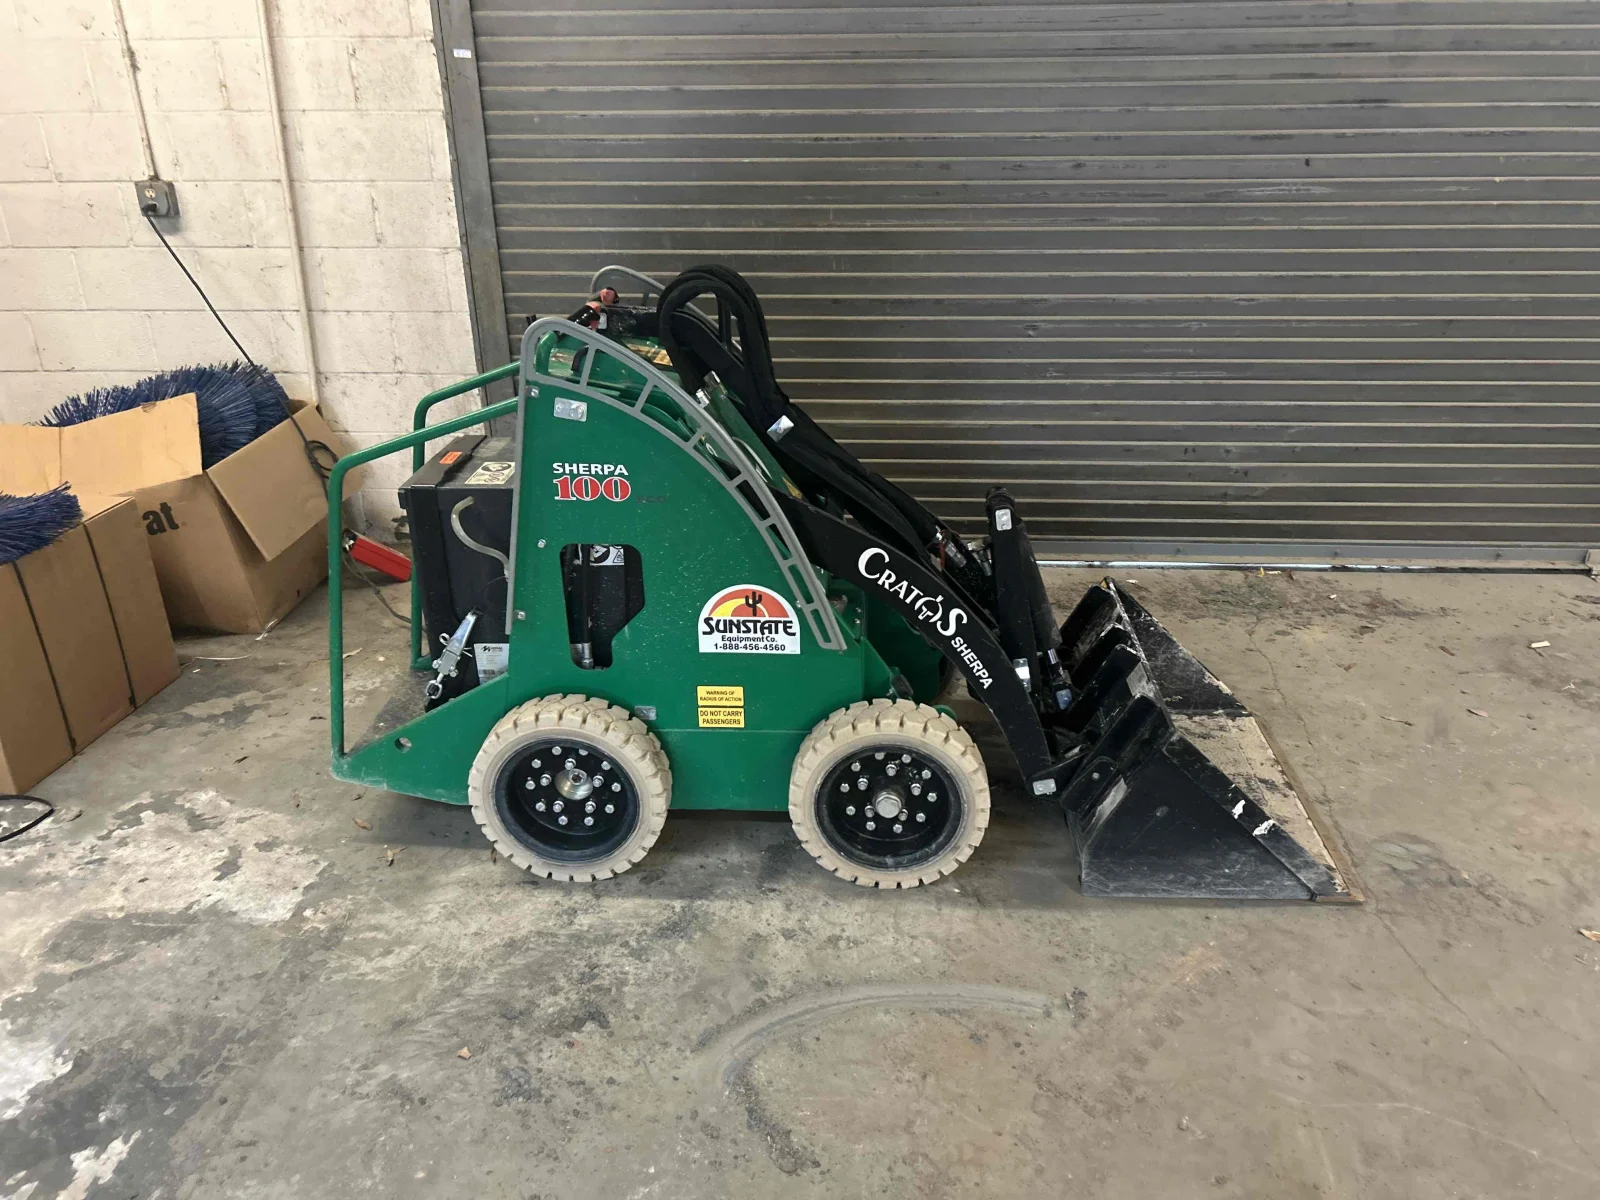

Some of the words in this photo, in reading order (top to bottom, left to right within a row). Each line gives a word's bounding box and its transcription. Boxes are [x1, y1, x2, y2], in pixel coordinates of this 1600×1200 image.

[552, 462, 629, 475] SHERPA
[552, 475, 631, 502] 100
[702, 616, 797, 636] SUNSTATE
[857, 547, 968, 637] CRATOS
[950, 636, 994, 690] SHERPA
[713, 642, 786, 652] 1-888-456-4560
[721, 635, 764, 643] Equipment
